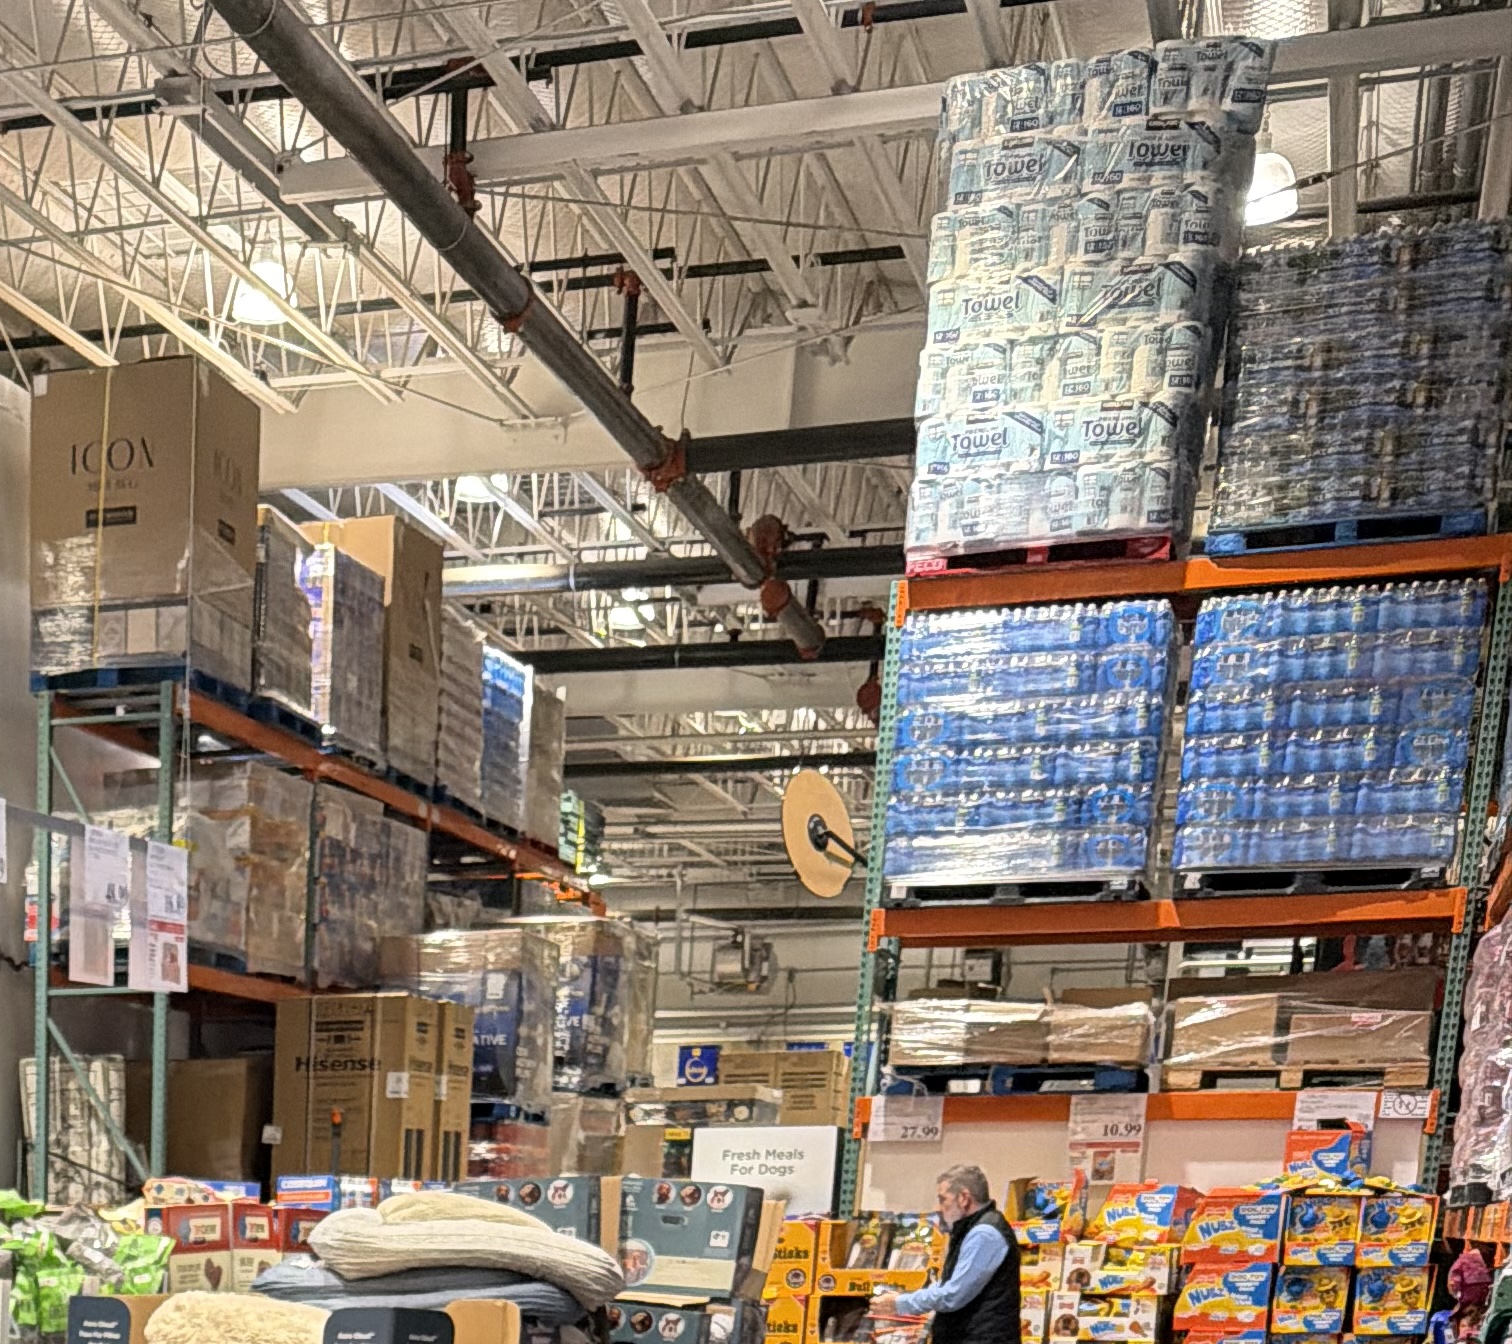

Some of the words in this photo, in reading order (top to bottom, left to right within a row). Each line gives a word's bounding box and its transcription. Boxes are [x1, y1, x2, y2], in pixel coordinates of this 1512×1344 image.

[961, 293, 1021, 316] Towel
[1081, 418, 1144, 441] Towel
[951, 429, 1009, 451] Towel
[295, 1056, 382, 1073] Hisense
[901, 1126, 939, 1140] 27.99
[1103, 1123, 1142, 1137] 10.99
[722, 1149, 760, 1162] Fresh
[765, 1149, 805, 1162] Meals
[730, 1164, 754, 1176] For
[758, 1163, 795, 1177] Dogs
[767, 1320, 798, 1334] ticks
